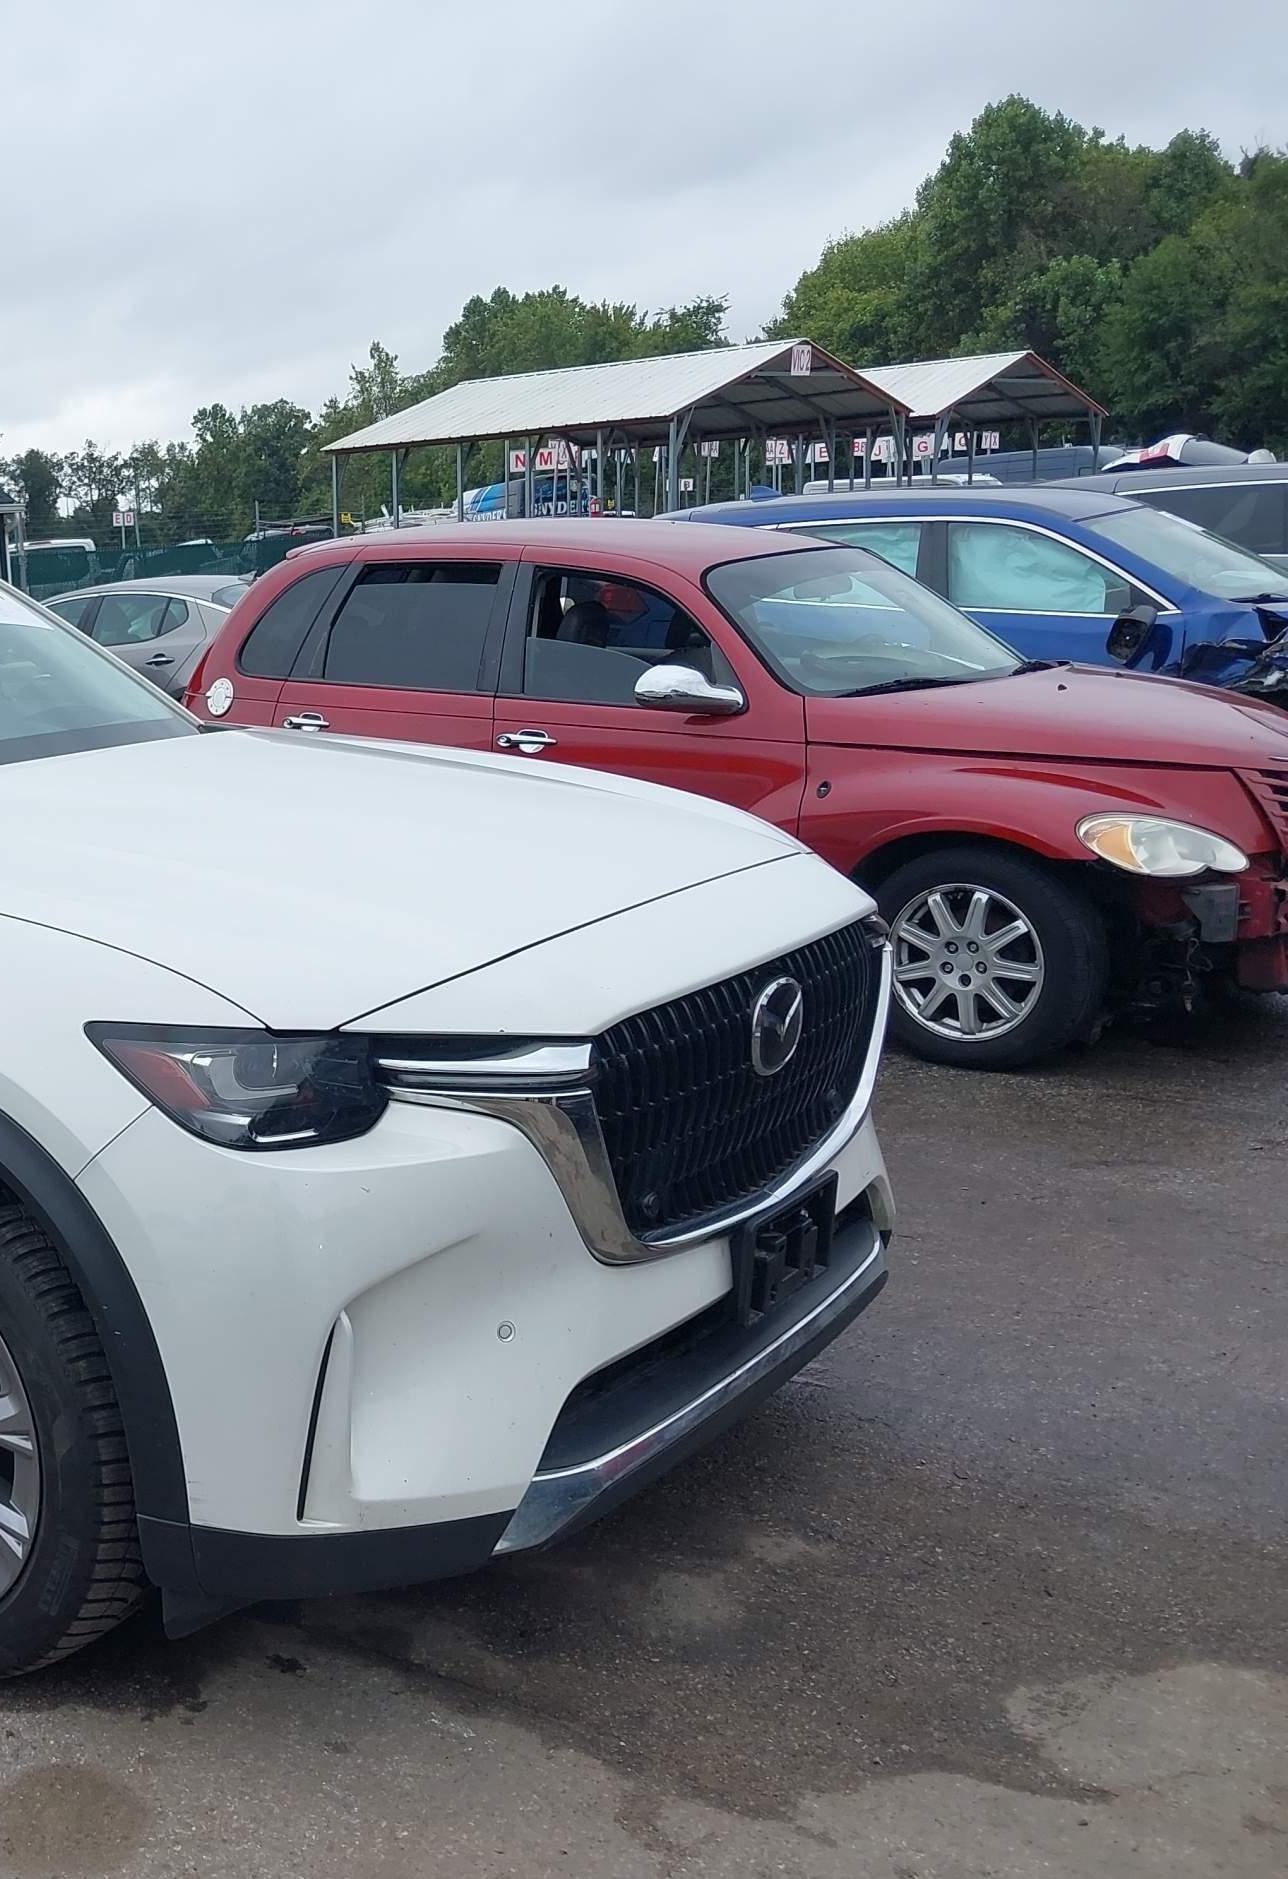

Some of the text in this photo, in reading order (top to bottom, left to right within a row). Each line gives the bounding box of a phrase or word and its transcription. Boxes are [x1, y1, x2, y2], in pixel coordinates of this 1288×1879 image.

[792, 349, 805, 371] VIC
[819, 447, 829, 459] E
[917, 441, 929, 453] G
[515, 454, 526, 469] N
[539, 451, 553, 466] M
[115, 513, 121, 524] E
